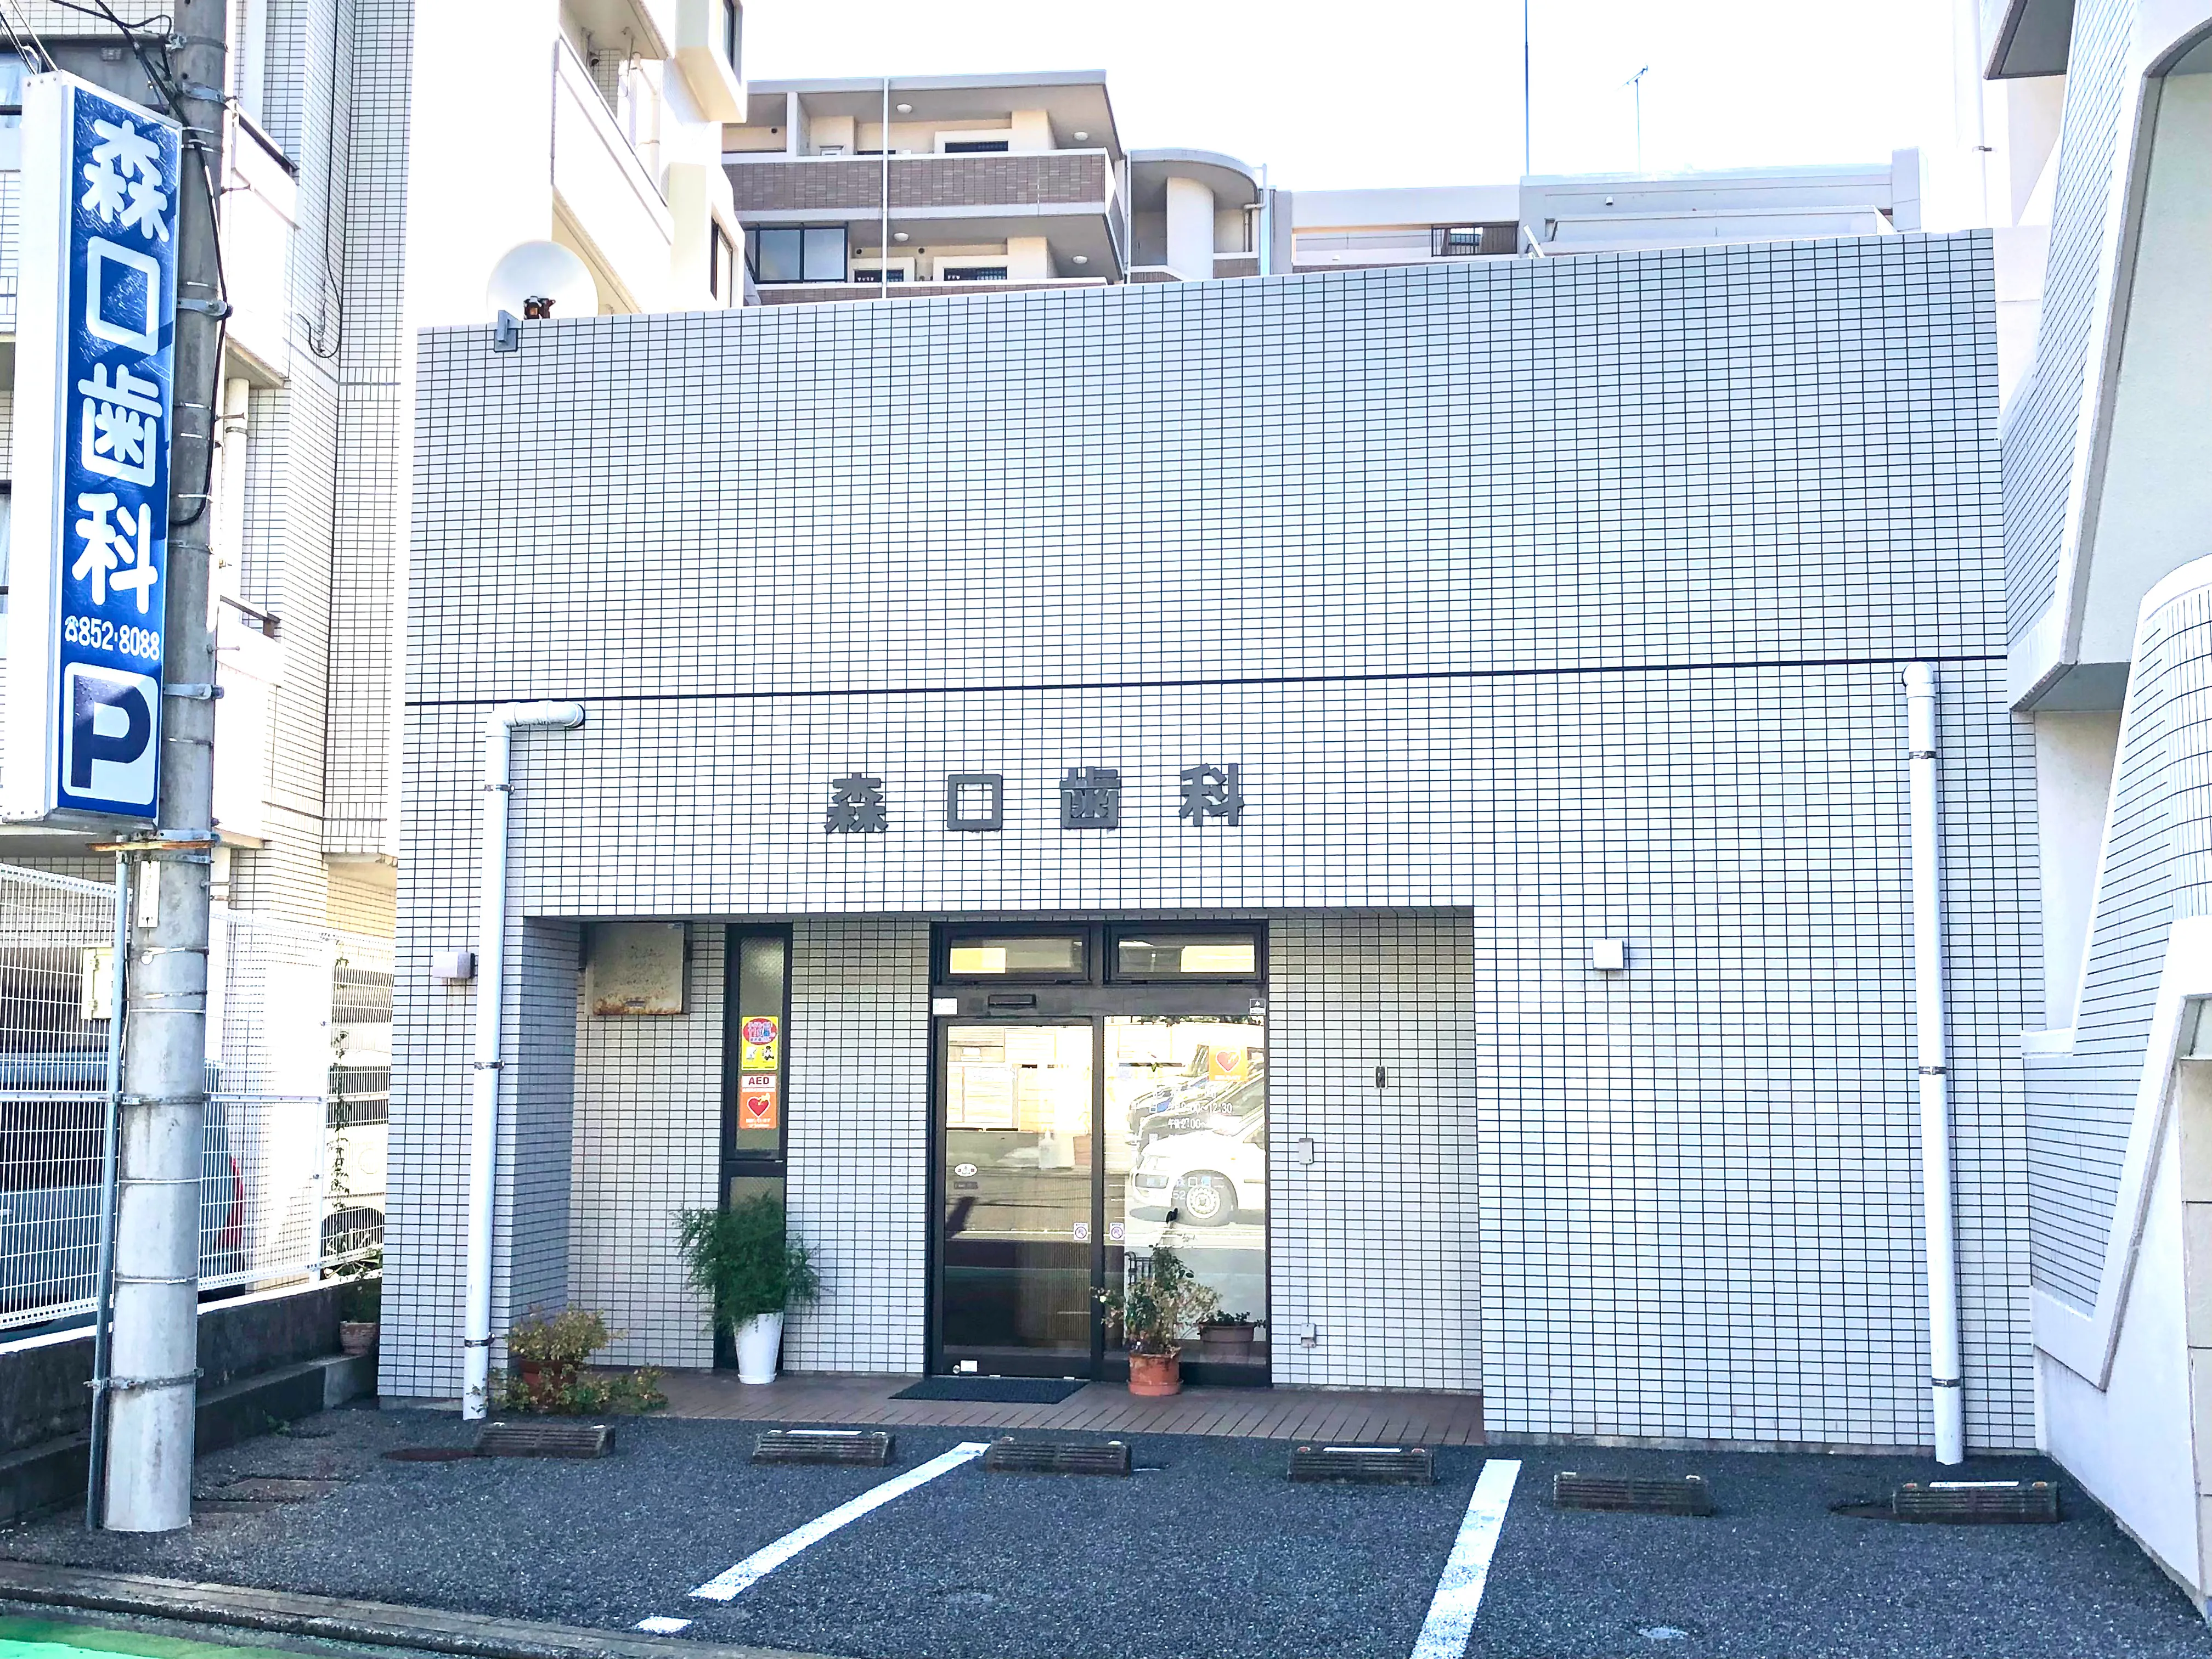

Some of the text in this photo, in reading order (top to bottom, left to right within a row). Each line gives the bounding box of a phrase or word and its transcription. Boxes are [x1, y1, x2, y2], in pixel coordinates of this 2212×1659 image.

[72, 119, 170, 614] 森口歯科
[70, 674, 151, 789] P
[825, 763, 1245, 833] 森口歯科
[748, 1076, 770, 1085] AED
